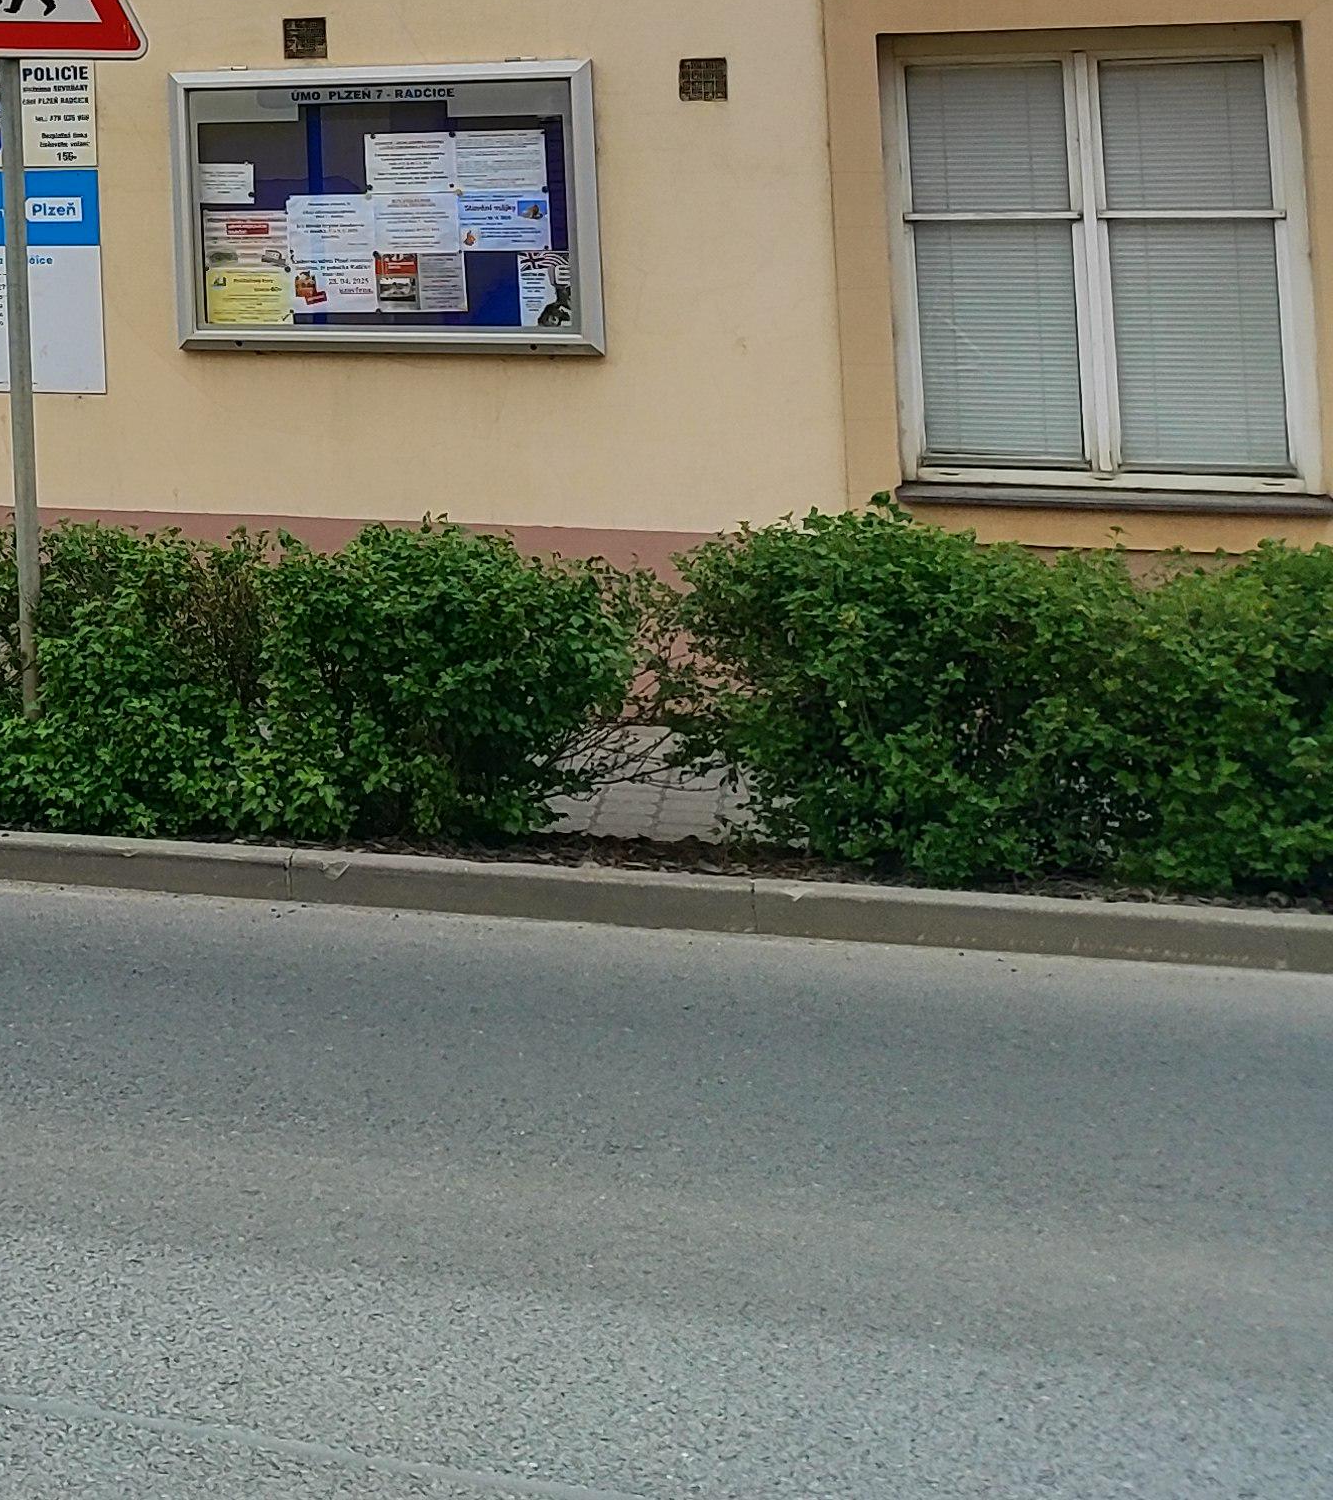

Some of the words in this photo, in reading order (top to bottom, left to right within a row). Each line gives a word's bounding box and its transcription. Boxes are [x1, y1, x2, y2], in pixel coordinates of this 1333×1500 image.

[22, 65, 89, 82] POLICIE
[328, 88, 371, 100] PLZEŇ
[376, 90, 383, 99] 7
[32, 202, 76, 216] Plzeň
